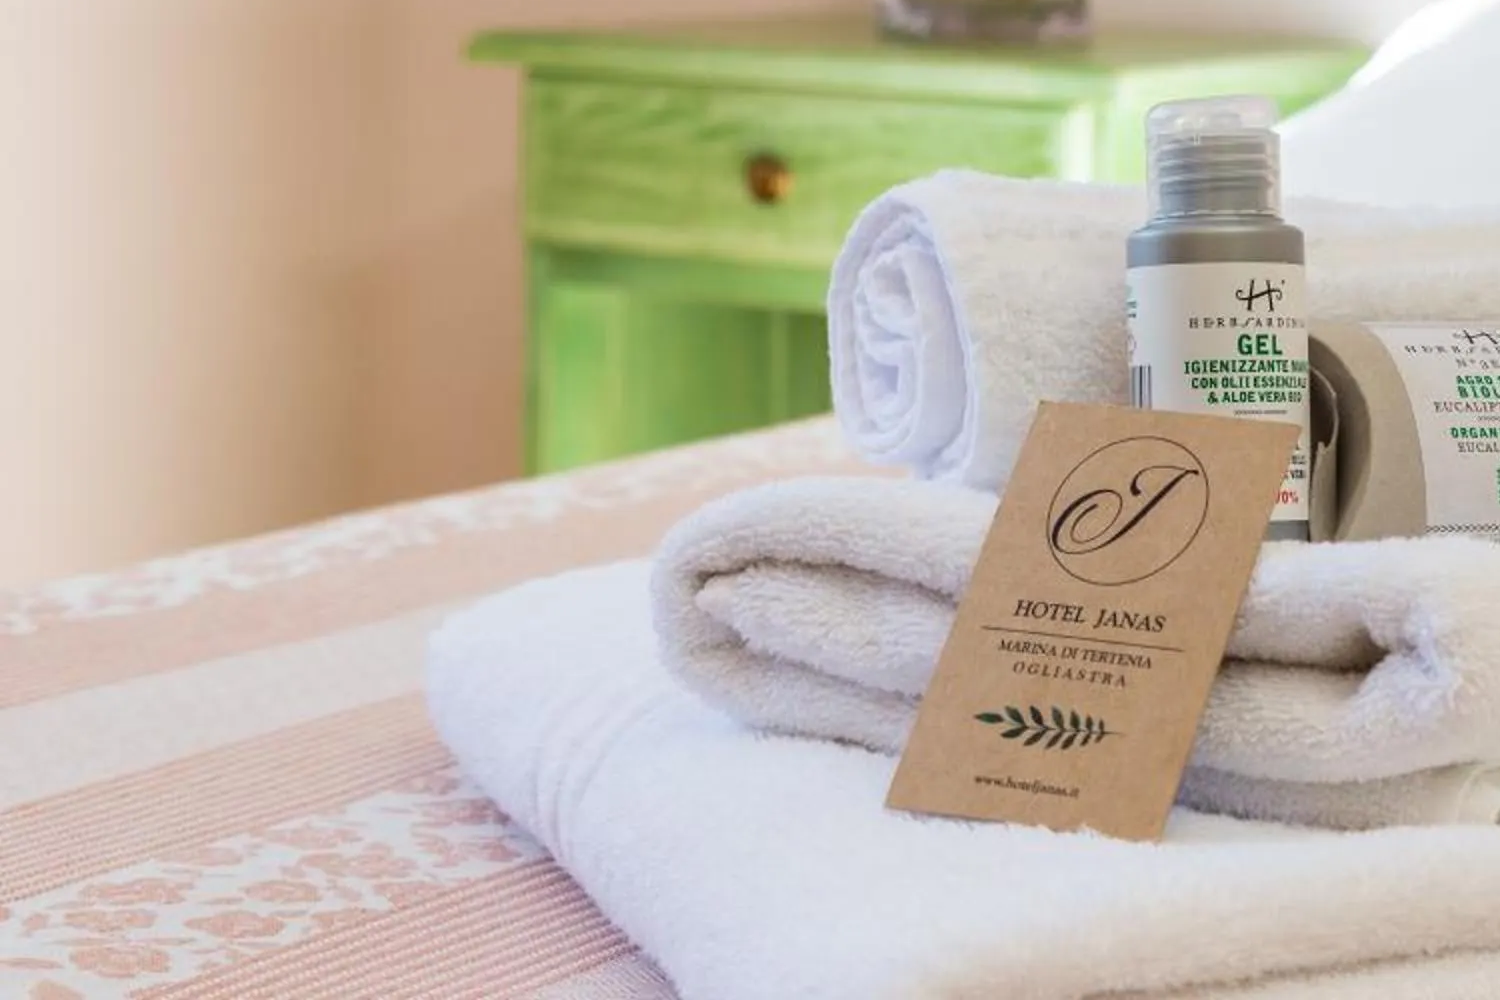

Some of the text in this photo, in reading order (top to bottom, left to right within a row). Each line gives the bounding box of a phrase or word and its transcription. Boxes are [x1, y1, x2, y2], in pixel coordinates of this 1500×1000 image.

[1238, 334, 1283, 355] GEL
[1184, 360, 1289, 374] IGIENIZZANTE
[1191, 377, 1217, 389] CON
[1221, 377, 1250, 389] OLII
[1456, 375, 1493, 386] AGRO
[1207, 391, 1219, 404] &
[1221, 391, 1256, 403] ALOE
[1258, 391, 1287, 403] VERA
[1013, 599, 1168, 633] HOTEL JANAS
[998, 639, 1153, 669] MARINA DI TERTENIA
[1012, 660, 1128, 688] OGLIASTRA
